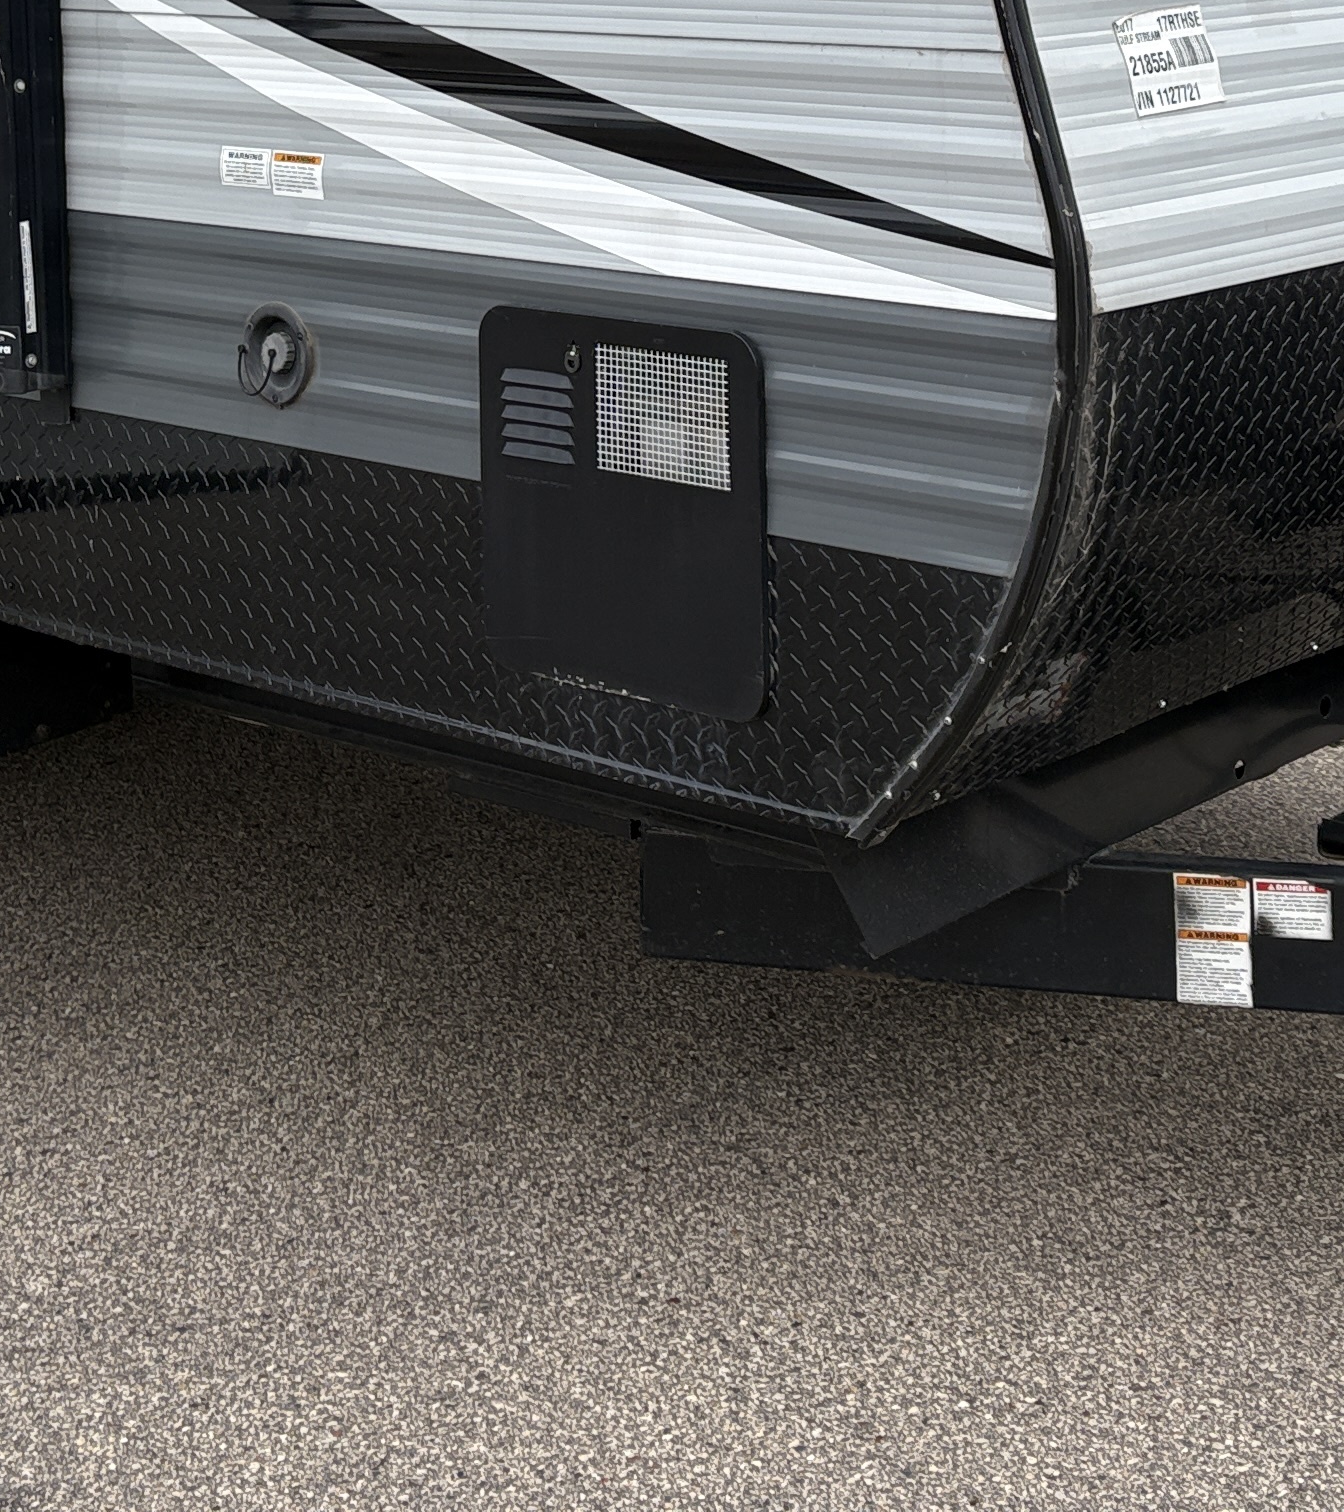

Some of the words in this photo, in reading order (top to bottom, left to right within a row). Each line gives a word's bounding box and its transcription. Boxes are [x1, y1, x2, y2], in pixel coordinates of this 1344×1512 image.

[1129, 50, 1176, 76] 21855A
[1136, 90, 1155, 110] VIN
[1157, 82, 1200, 106] 1127721
[1194, 877, 1237, 887] WARNING
[1276, 883, 1315, 892] DANGER
[1194, 932, 1238, 941] WARNING
